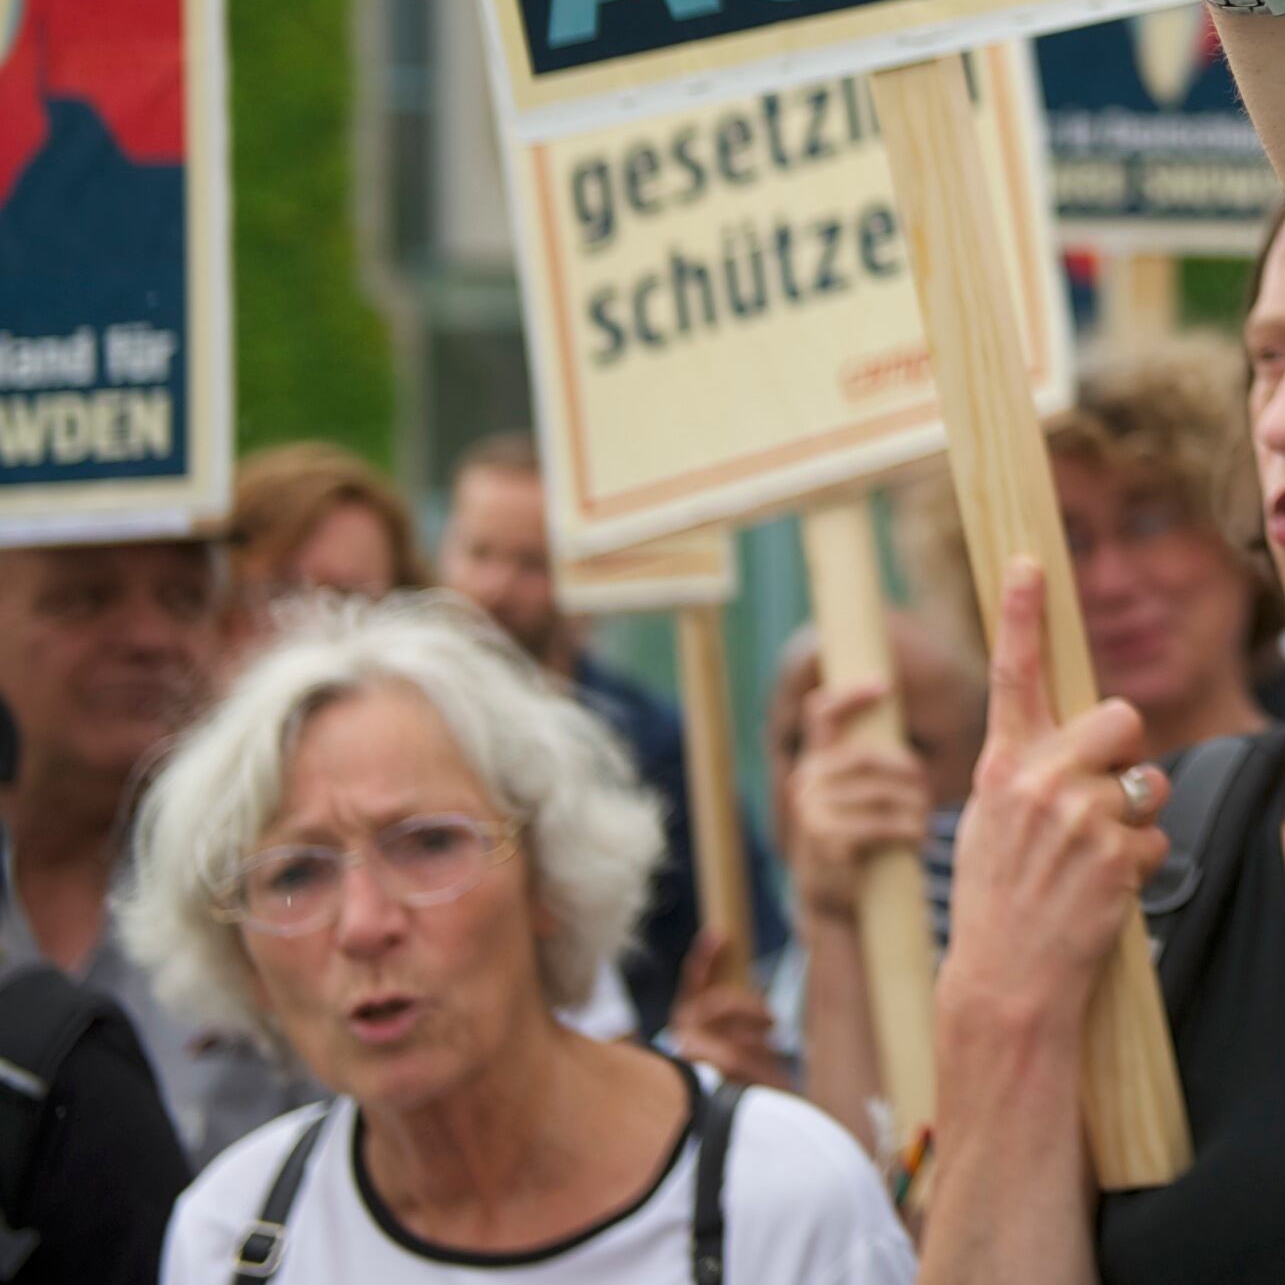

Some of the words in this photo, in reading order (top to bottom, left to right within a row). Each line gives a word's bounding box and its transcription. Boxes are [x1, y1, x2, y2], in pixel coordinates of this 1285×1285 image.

[572, 55, 978, 257] gesetzl
[104, 321, 176, 384] für
[586, 199, 903, 367] schütze
